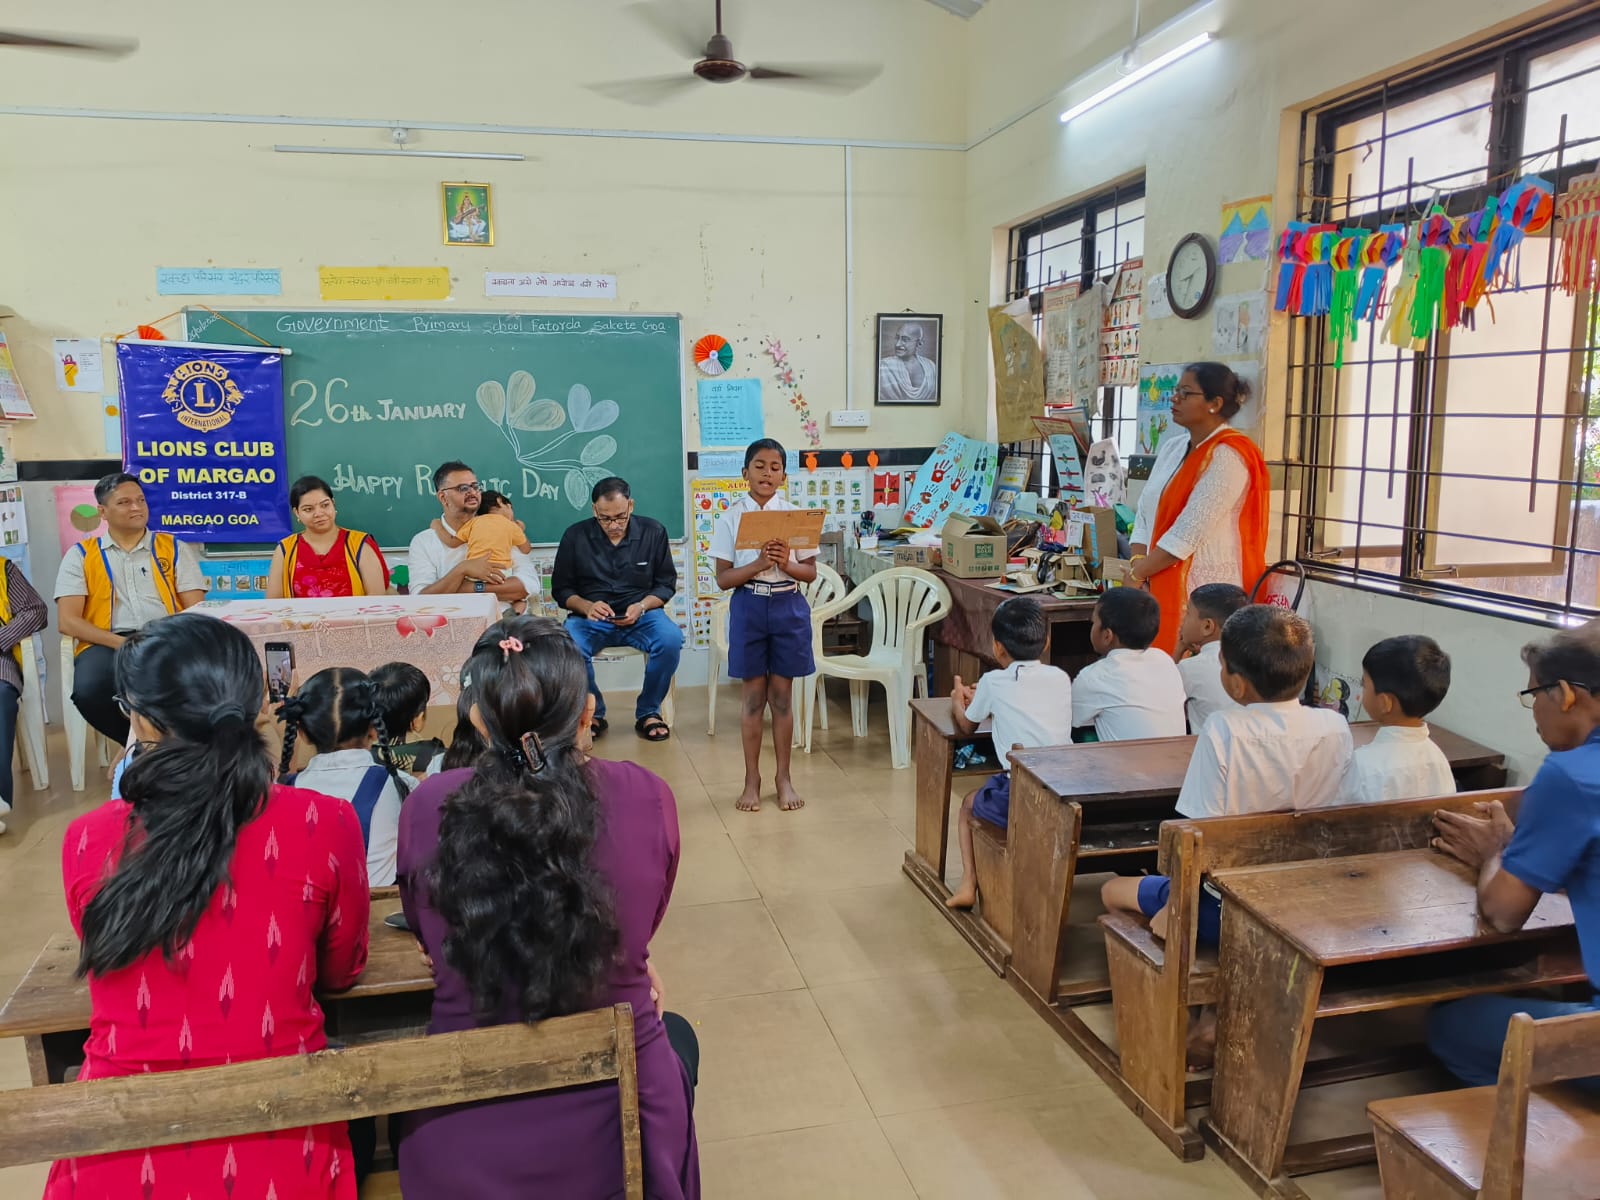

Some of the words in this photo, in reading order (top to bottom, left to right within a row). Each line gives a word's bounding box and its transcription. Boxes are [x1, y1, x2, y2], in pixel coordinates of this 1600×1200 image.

[276, 313, 390, 332] Government
[412, 316, 471, 331] Primary
[531, 317, 581, 330] Fatorda
[177, 362, 225, 378] LIONS
[193, 382, 216, 408] L
[289, 377, 373, 427] 26th
[180, 415, 227, 428] INTERNATIONAL
[136, 441, 208, 457] LIONS
[214, 441, 275, 457] CLUB
[139, 468, 170, 484] OF
[177, 468, 276, 484] MARGAO
[171, 491, 213, 500] District
[215, 491, 247, 500] 317-B
[161, 514, 225, 526] MARGAO
[227, 514, 259, 526] GOA
